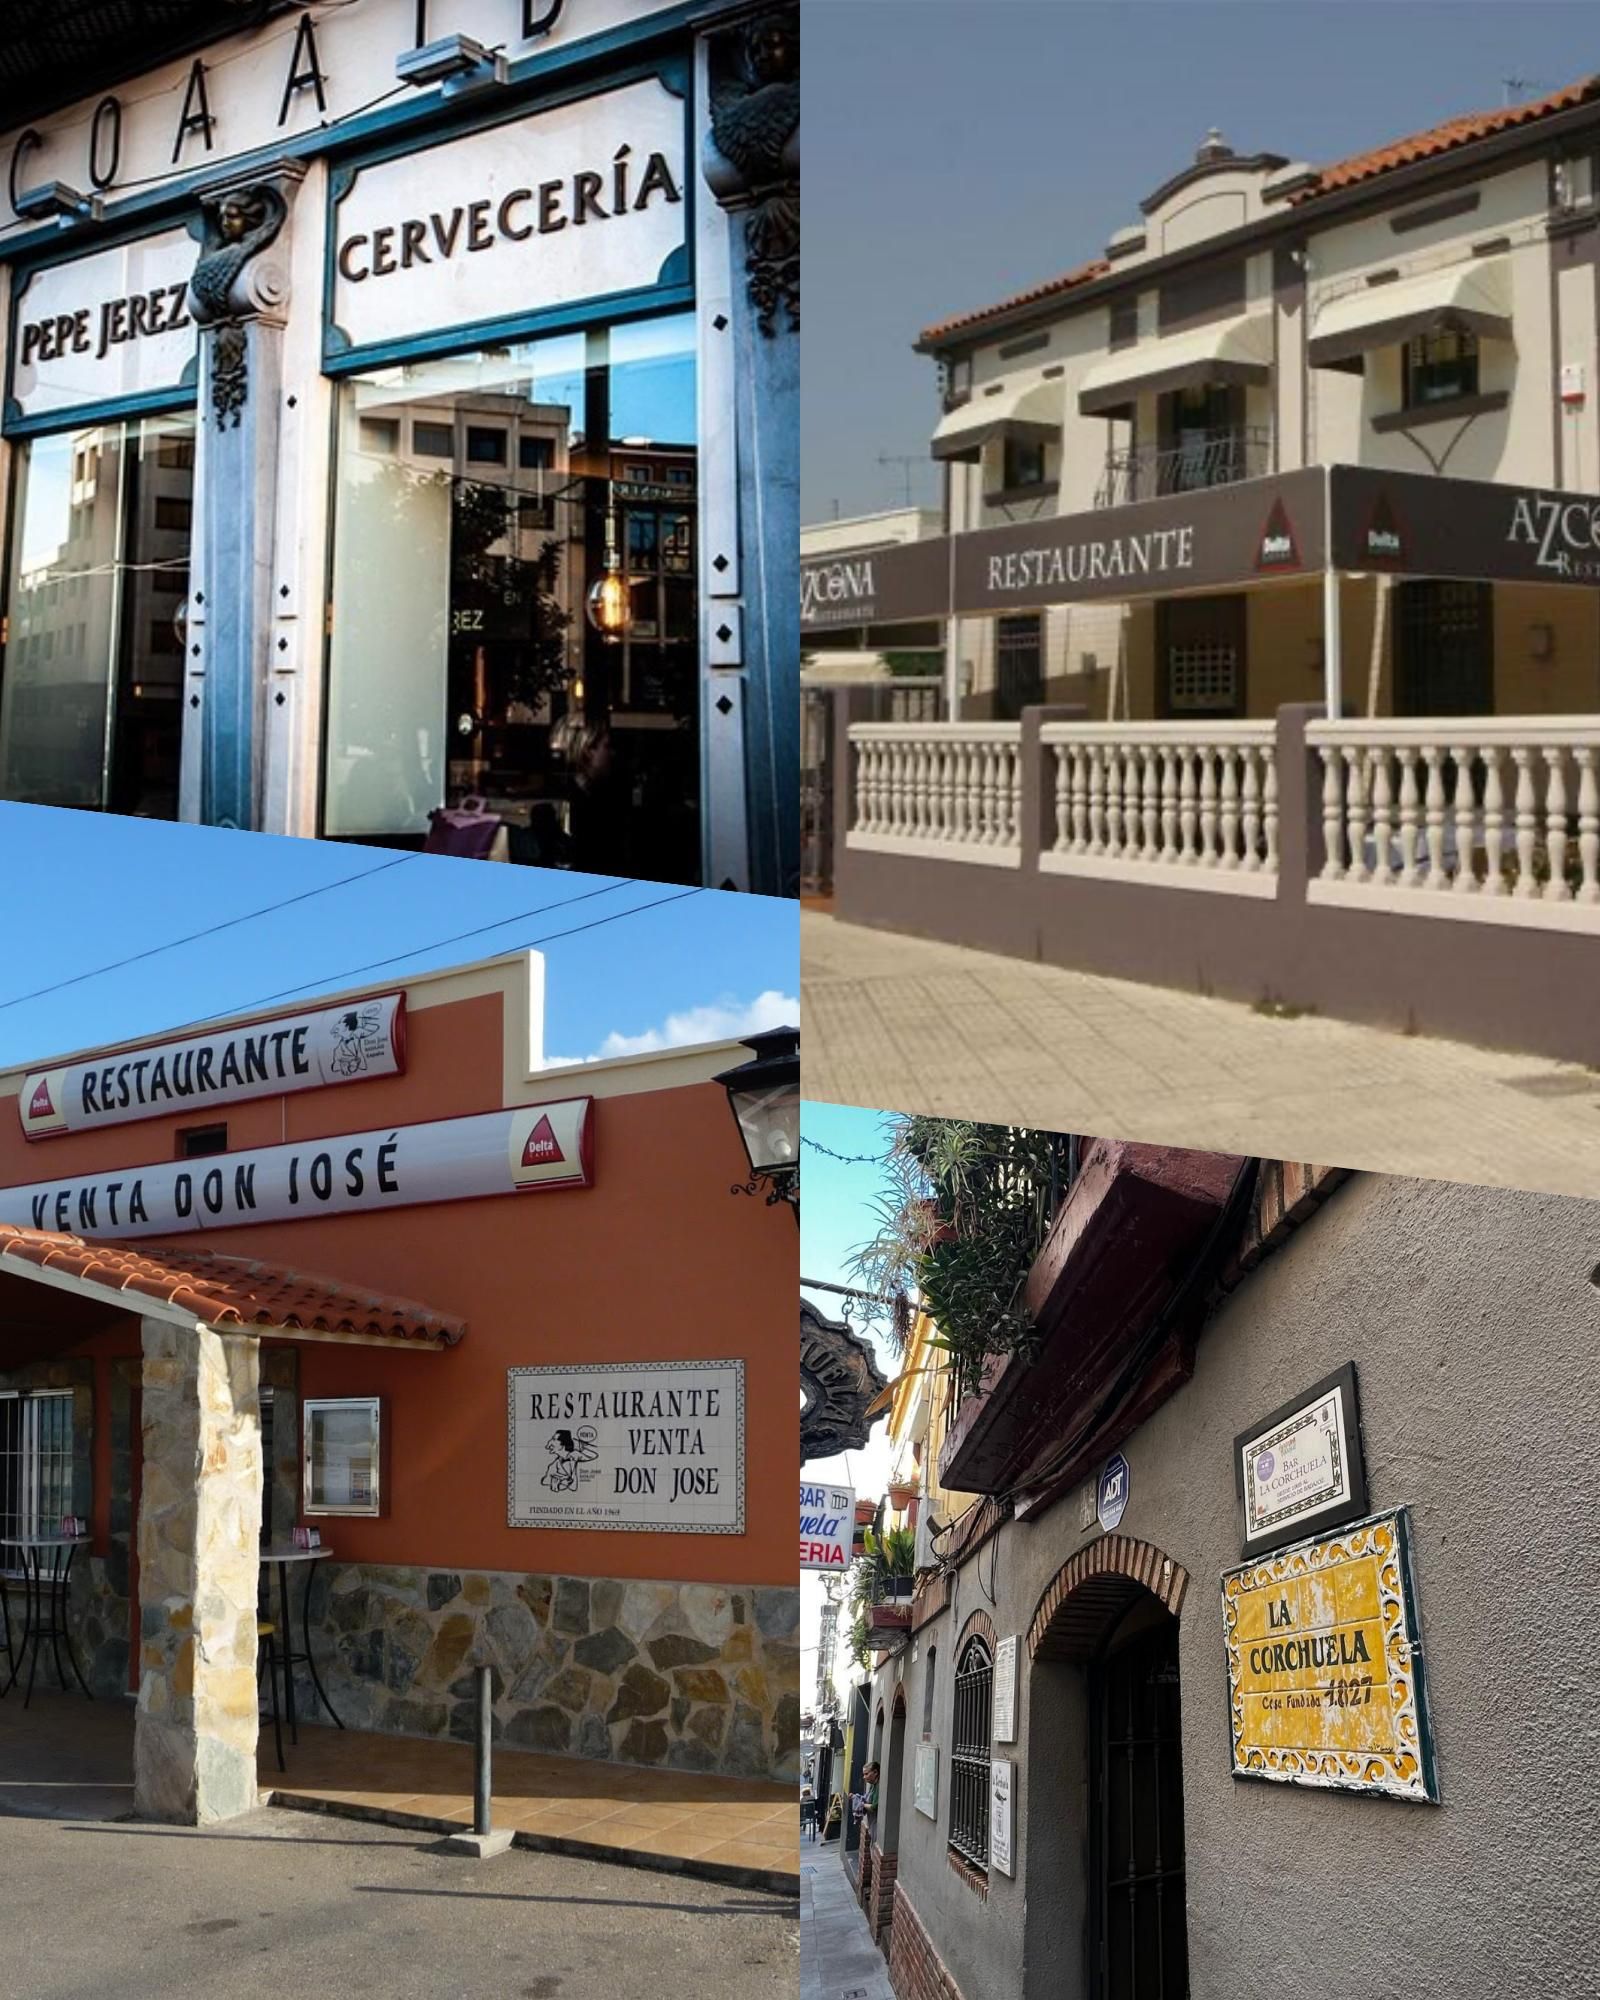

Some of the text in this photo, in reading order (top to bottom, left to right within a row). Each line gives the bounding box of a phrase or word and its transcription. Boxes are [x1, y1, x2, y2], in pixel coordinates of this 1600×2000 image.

[338, 143, 682, 282] CERVECERÍA
[22, 281, 191, 366] PEPE JEREZ
[987, 526, 1193, 590] RESTAURANTE
[82, 1026, 309, 1114] RESTAURANTE
[529, 1140, 553, 1154] Delta
[31, 1132, 399, 1232] VENTA DON JOSÉ
[530, 1388, 720, 1420] RESTAURANTE
[628, 1428, 706, 1455] VENTA
[1259, 1484, 1271, 1497] LA
[1271, 1456, 1327, 1489] CORCHUELA
[1282, 1457, 1299, 1473] BAR
[613, 1466, 719, 1503] DON JOSE
[1103, 1470, 1124, 1505] ADT
[528, 1506, 563, 1514] FUNDADO
[564, 1507, 575, 1515] EN
[576, 1507, 585, 1515] EL
[586, 1506, 603, 1516] AÑO
[1268, 1599, 1292, 1628] LA
[1250, 1630, 1372, 1675] CORCHUELA
